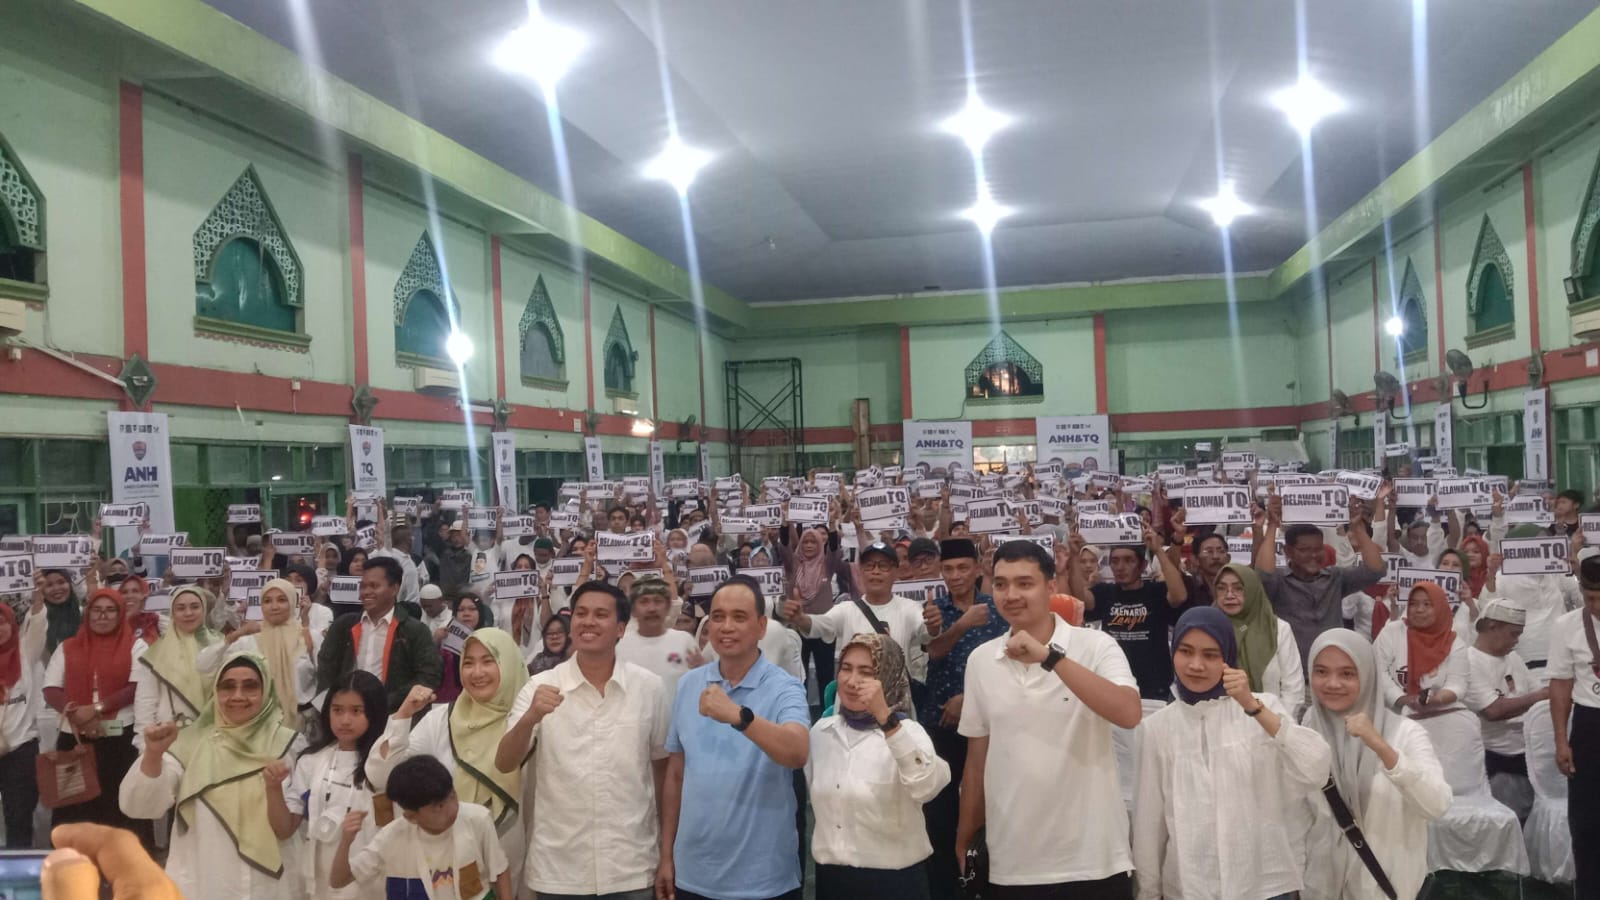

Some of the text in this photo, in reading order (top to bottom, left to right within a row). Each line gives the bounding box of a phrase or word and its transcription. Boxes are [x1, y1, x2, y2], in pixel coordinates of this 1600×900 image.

[915, 439, 964, 449] ANH&TQ
[1049, 434, 1099, 444] ANH&TQ
[1242, 454, 1255, 462] TQ
[124, 466, 158, 482] ANH
[361, 462, 374, 476] TQ
[1438, 485, 1469, 495] RELAWAN
[887, 491, 907, 504] TQ
[1187, 491, 1249, 509] RELAWAN TQ
[1282, 489, 1348, 508] RELAWAN TQ
[128, 506, 143, 518] TQ
[247, 507, 259, 515] TQ
[767, 507, 781, 518] TQ
[813, 501, 828, 512] TQ
[970, 507, 998, 518] RELAWAN
[1024, 503, 1039, 515] TQ
[521, 518, 533, 527] TQ
[1080, 518, 1115, 529] RELAWAN
[168, 535, 185, 546] TQ
[299, 536, 314, 546] TQ
[34, 541, 90, 555] RELAWAN TQ
[1504, 543, 1567, 560] RELAWAN TQ
[203, 553, 222, 566] TQ
[6, 560, 31, 577] TQ
[521, 573, 538, 586] TQ
[764, 571, 781, 584] TQ
[332, 582, 357, 591] RELAWAN
[1435, 576, 1457, 592] TQ
